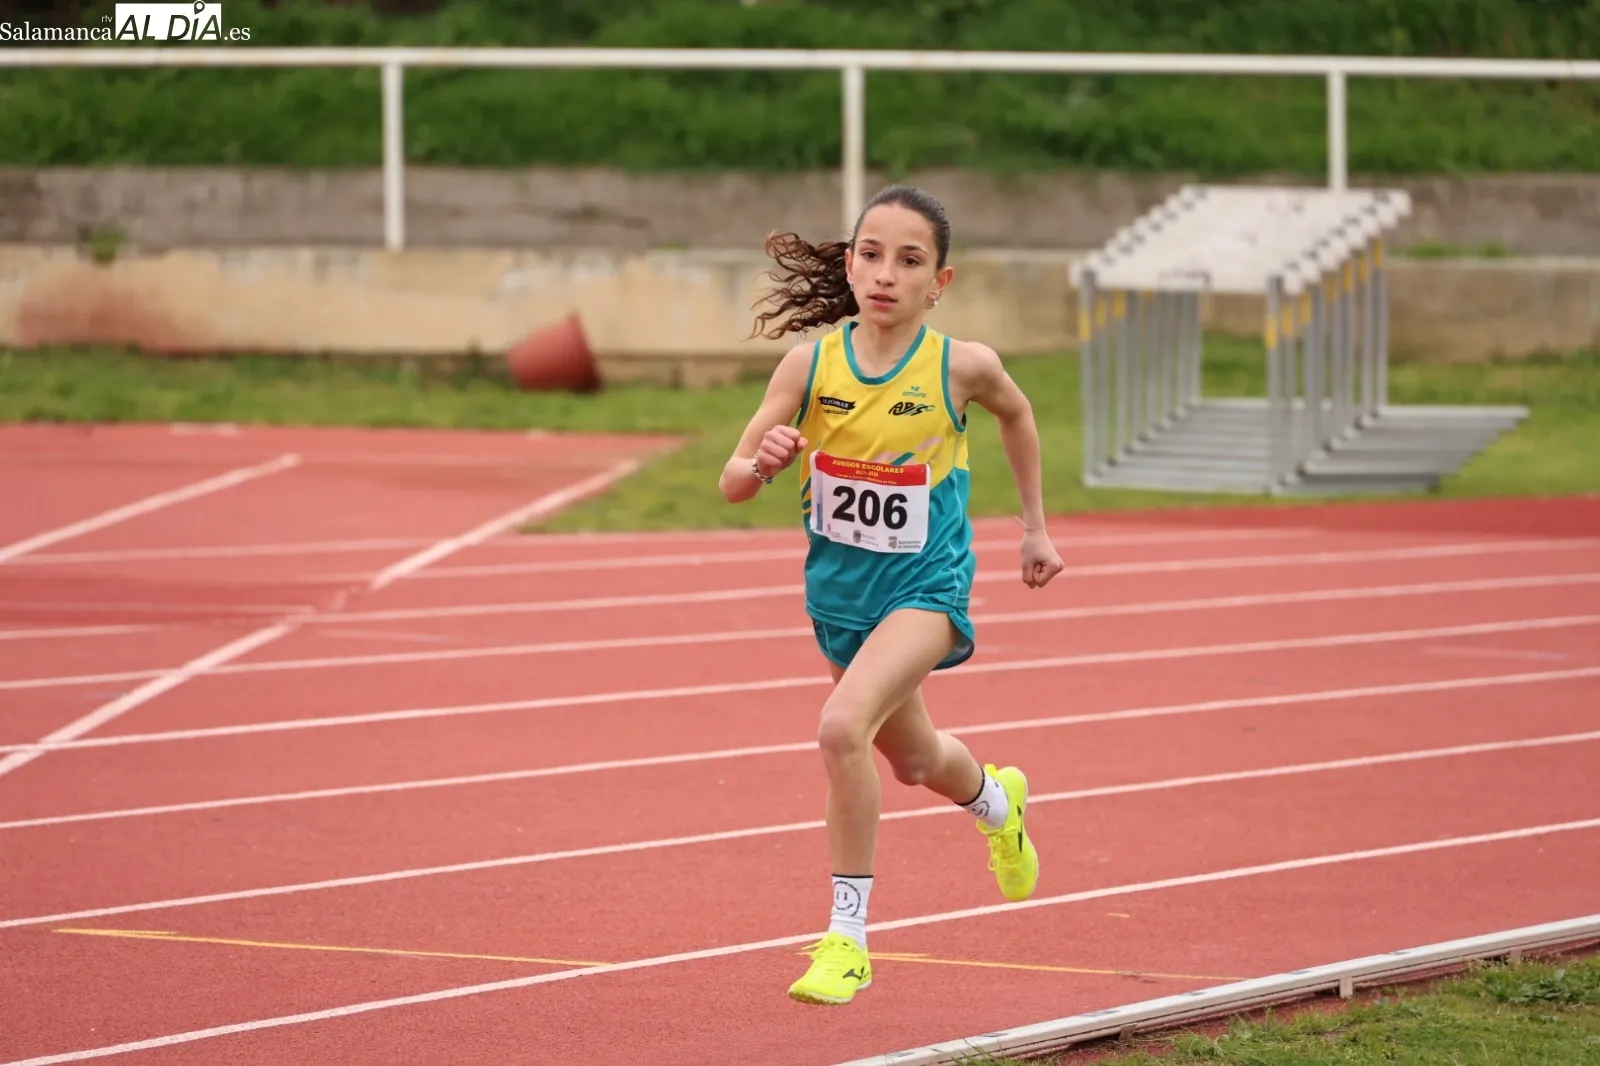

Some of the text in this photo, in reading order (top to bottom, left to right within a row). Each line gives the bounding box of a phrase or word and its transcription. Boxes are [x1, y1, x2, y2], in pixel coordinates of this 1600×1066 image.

[832, 459, 905, 474] JUEGOS ESCOLARES
[832, 485, 908, 530] 206
